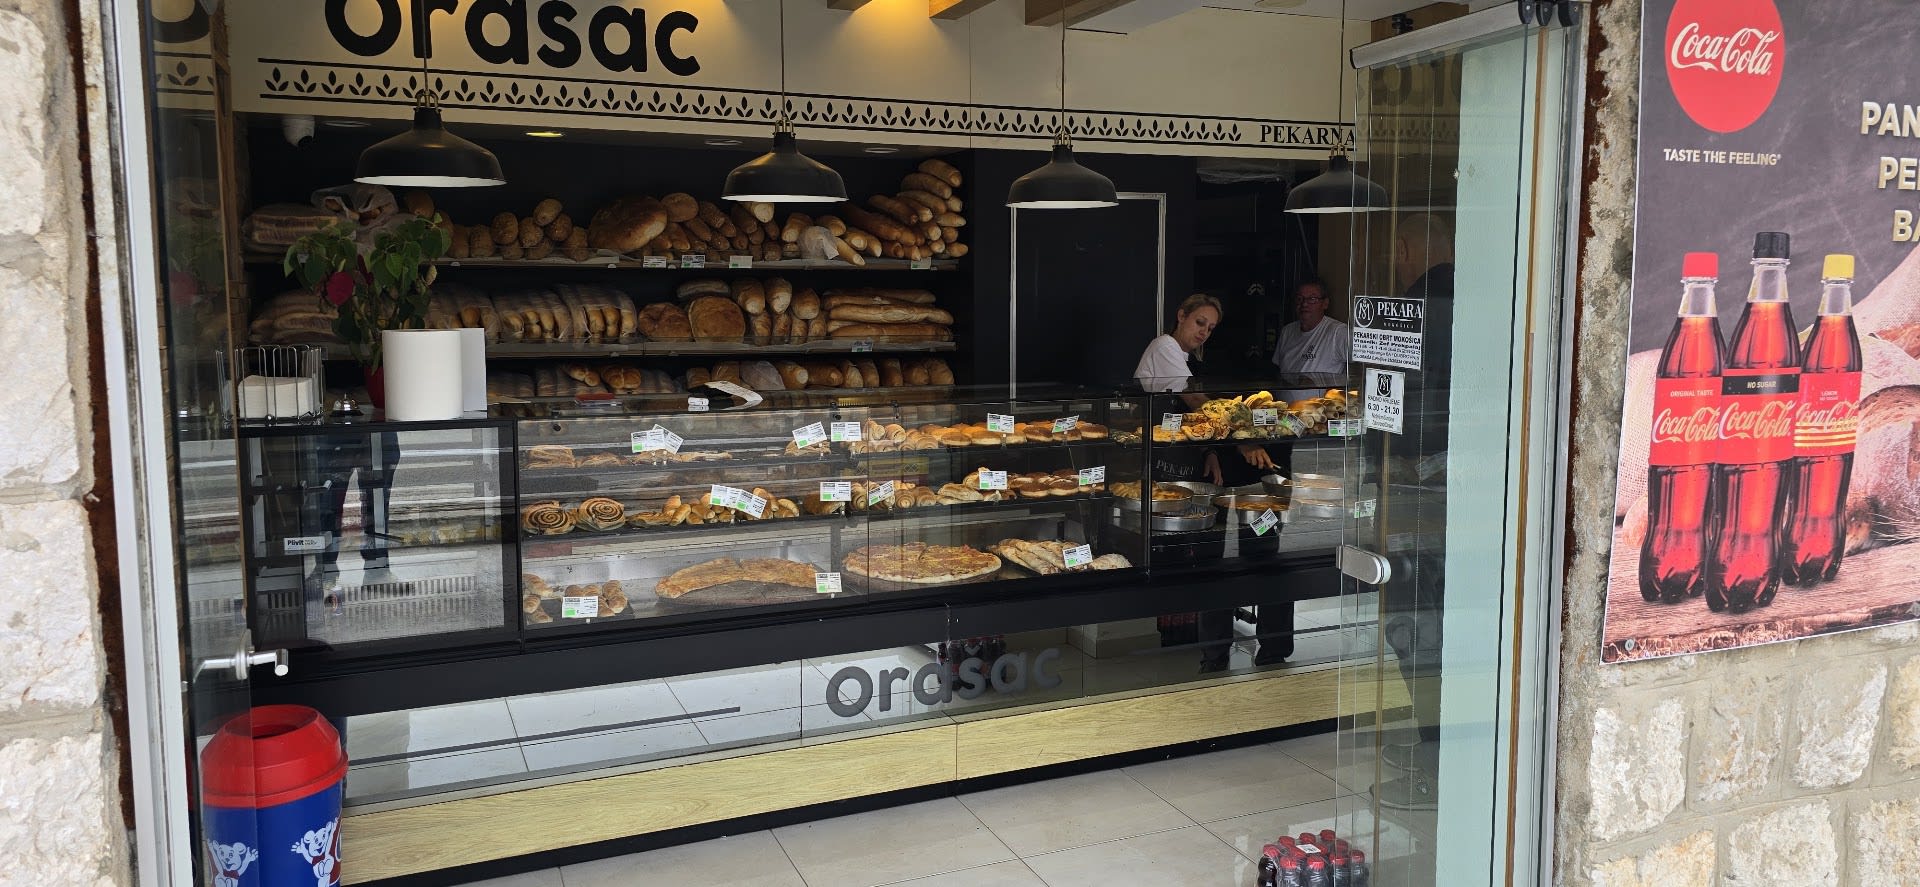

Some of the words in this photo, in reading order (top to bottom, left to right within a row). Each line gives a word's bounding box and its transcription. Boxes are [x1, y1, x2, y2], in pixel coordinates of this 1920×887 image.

[1671, 23, 1780, 76] Coca-Cola
[1663, 149, 1700, 162] TASTE
[1703, 150, 1726, 163] THE
[1878, 156, 1920, 191] PE
[1377, 301, 1422, 319] PEKARA
[1353, 332, 1378, 341] PEKARSKI
[1379, 334, 1392, 342] OBRT
[1393, 335, 1420, 344] MOKOŠICA
[1670, 390, 1696, 398] ORIGINAL
[1697, 389, 1713, 397] TASTE
[1747, 381, 1755, 389] NO
[1756, 381, 1777, 389] SUGAR
[1651, 406, 1720, 443] Coca-Cola
[1719, 400, 1796, 440] Coca-Cola
